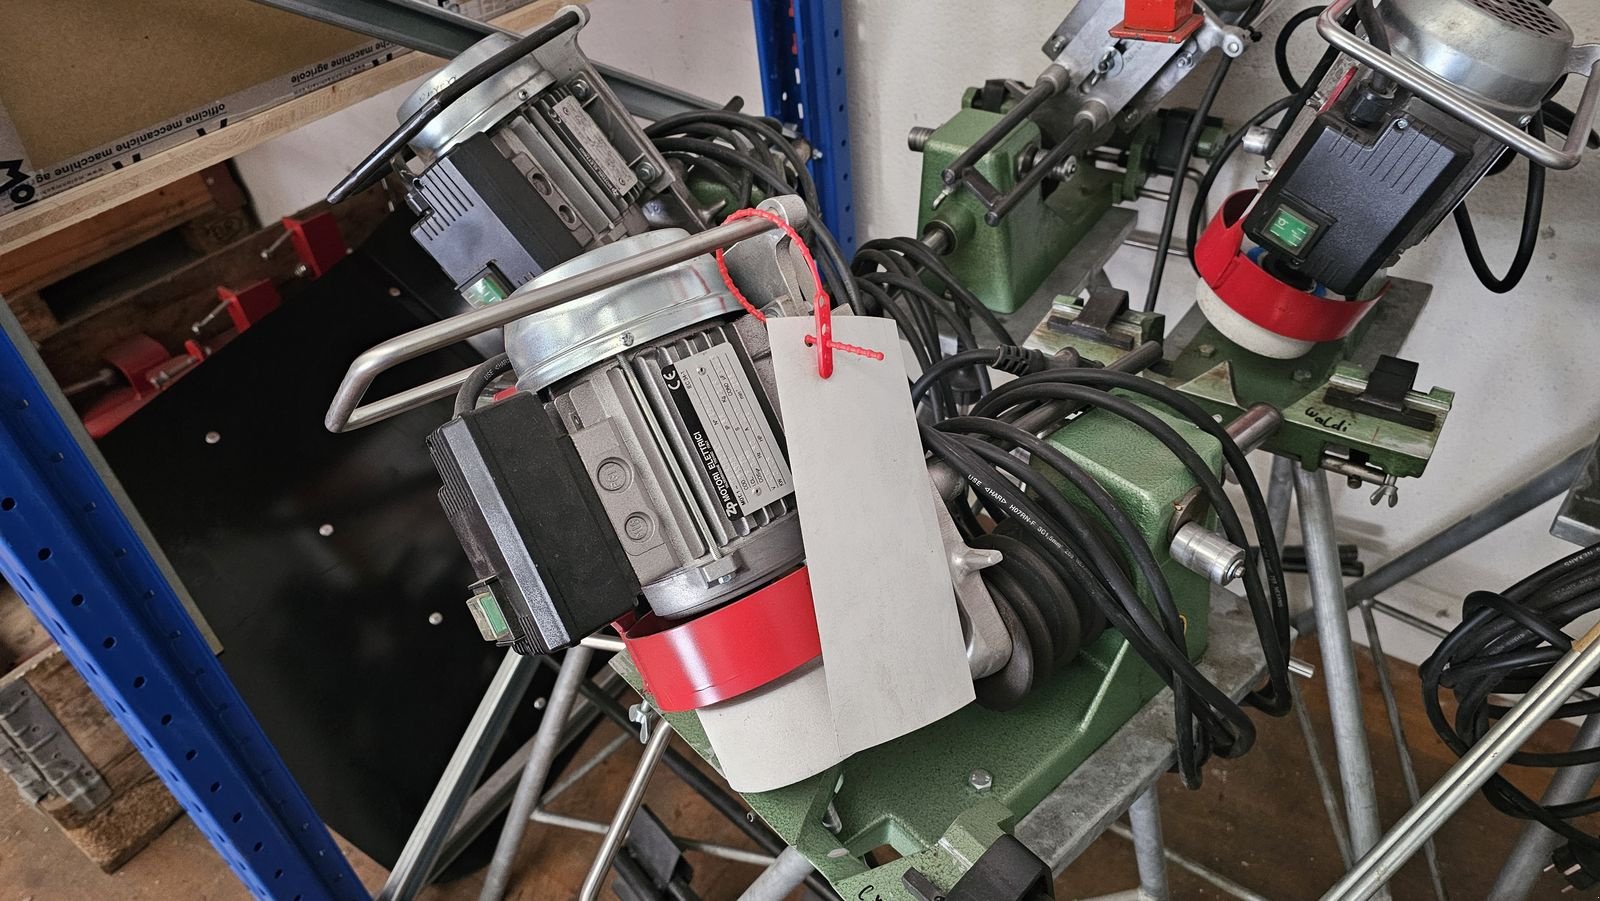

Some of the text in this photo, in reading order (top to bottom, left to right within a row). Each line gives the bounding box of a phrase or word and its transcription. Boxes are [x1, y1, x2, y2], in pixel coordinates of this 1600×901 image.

[330, 46, 374, 68] macchine
[291, 62, 328, 84] agricole
[186, 103, 225, 124] officine
[116, 120, 182, 152] meccaniche
[54, 148, 112, 177] macchine
[663, 370, 680, 390] CE
[693, 431, 716, 470] ELETTRICI
[712, 472, 732, 502] MOTORI
[968, 474, 982, 487] USE
[1009, 504, 1036, 526] H07RN-F
